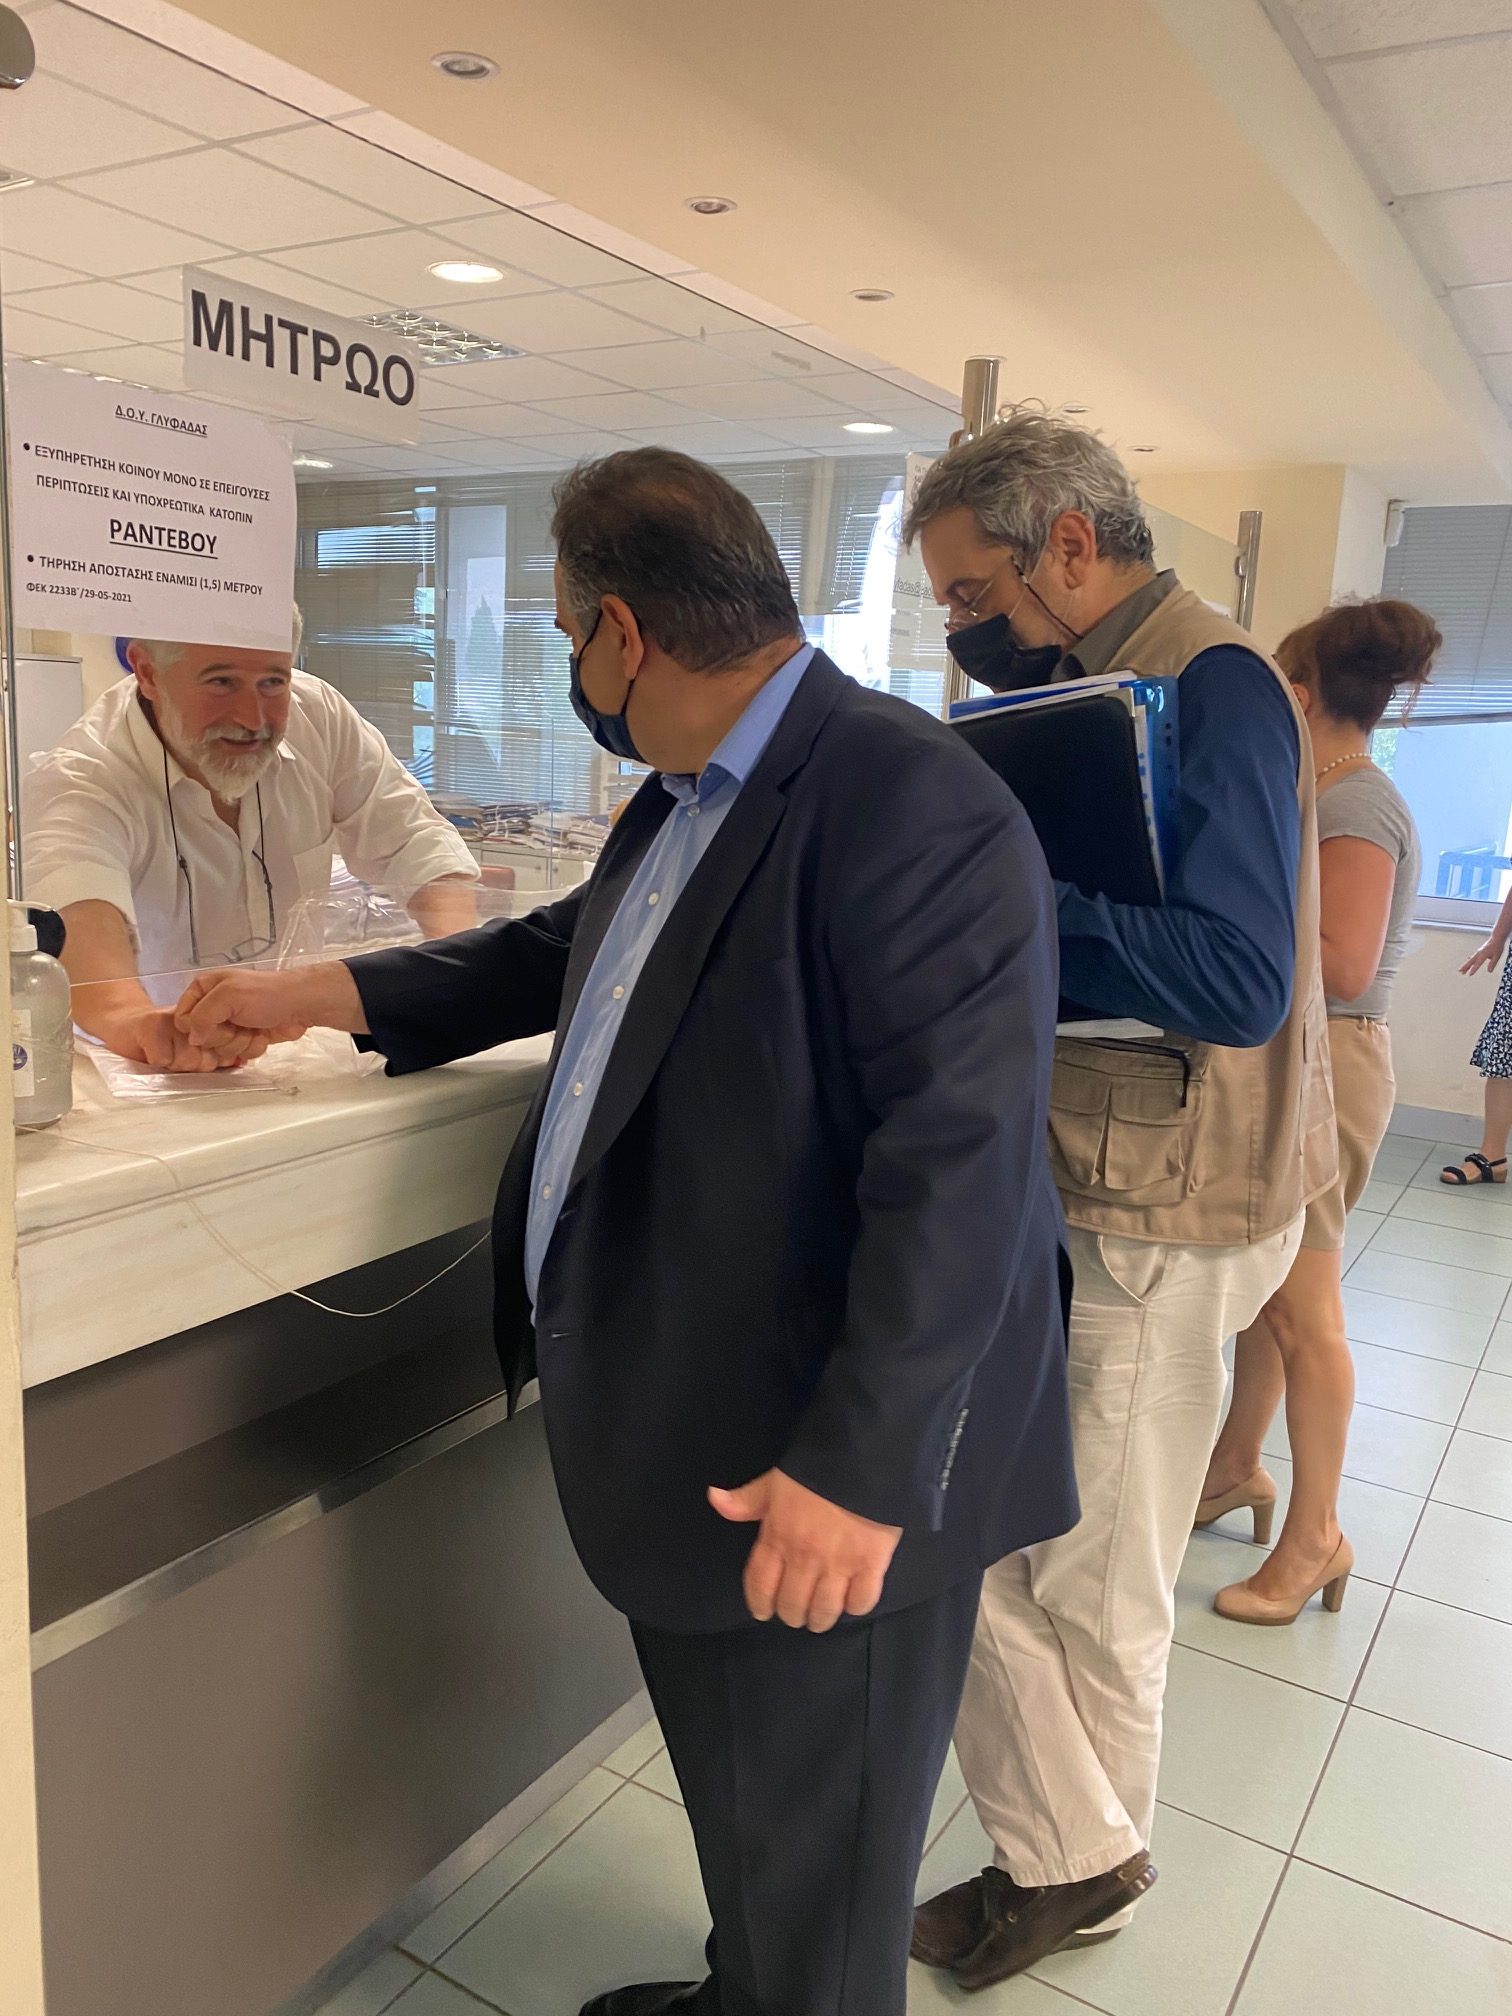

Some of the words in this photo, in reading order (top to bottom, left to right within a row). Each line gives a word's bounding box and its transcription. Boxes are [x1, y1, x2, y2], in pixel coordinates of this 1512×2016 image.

[191, 289, 415, 406] ΜΗΤΡΩΟ
[115, 405, 148, 422] Δ.Ο.Υ.
[151, 413, 208, 435] ΓΛΥΦΑΔΑΣ
[35, 445, 116, 472] ΕΞΥΠΗΡΕΤΗΣΗ
[119, 462, 160, 480] ΚΟΙΝΟΥ
[163, 471, 197, 487] ΜΟΝΟ
[199, 478, 211, 490] ΣΕ
[213, 481, 270, 501] ΕΠΕΙΓΟΥΣΕΣ
[36, 474, 110, 499] ΠΕΡΙΠΤΩΣΕΙΣ
[112, 488, 131, 502] ΚΑΙ
[133, 492, 205, 516] ΥΠΟΧΡΕΩΤΙΚΑ
[209, 506, 253, 524] ΚΑΤΟΠΙΝ
[110, 518, 217, 554] ΡΑΝΤΕΒΟΥ
[26, 582, 47, 593] ΦΕΚ
[39, 555, 86, 573] ΤΗΡΗΣΗ
[89, 563, 154, 581] ΑΠΟΣΤΑΣΗΣ
[156, 571, 197, 587] ΕΝΑΜΙΣΙ
[200, 577, 221, 592] (1,5)
[223, 581, 263, 596] ΜΕΤΡΟΥ
